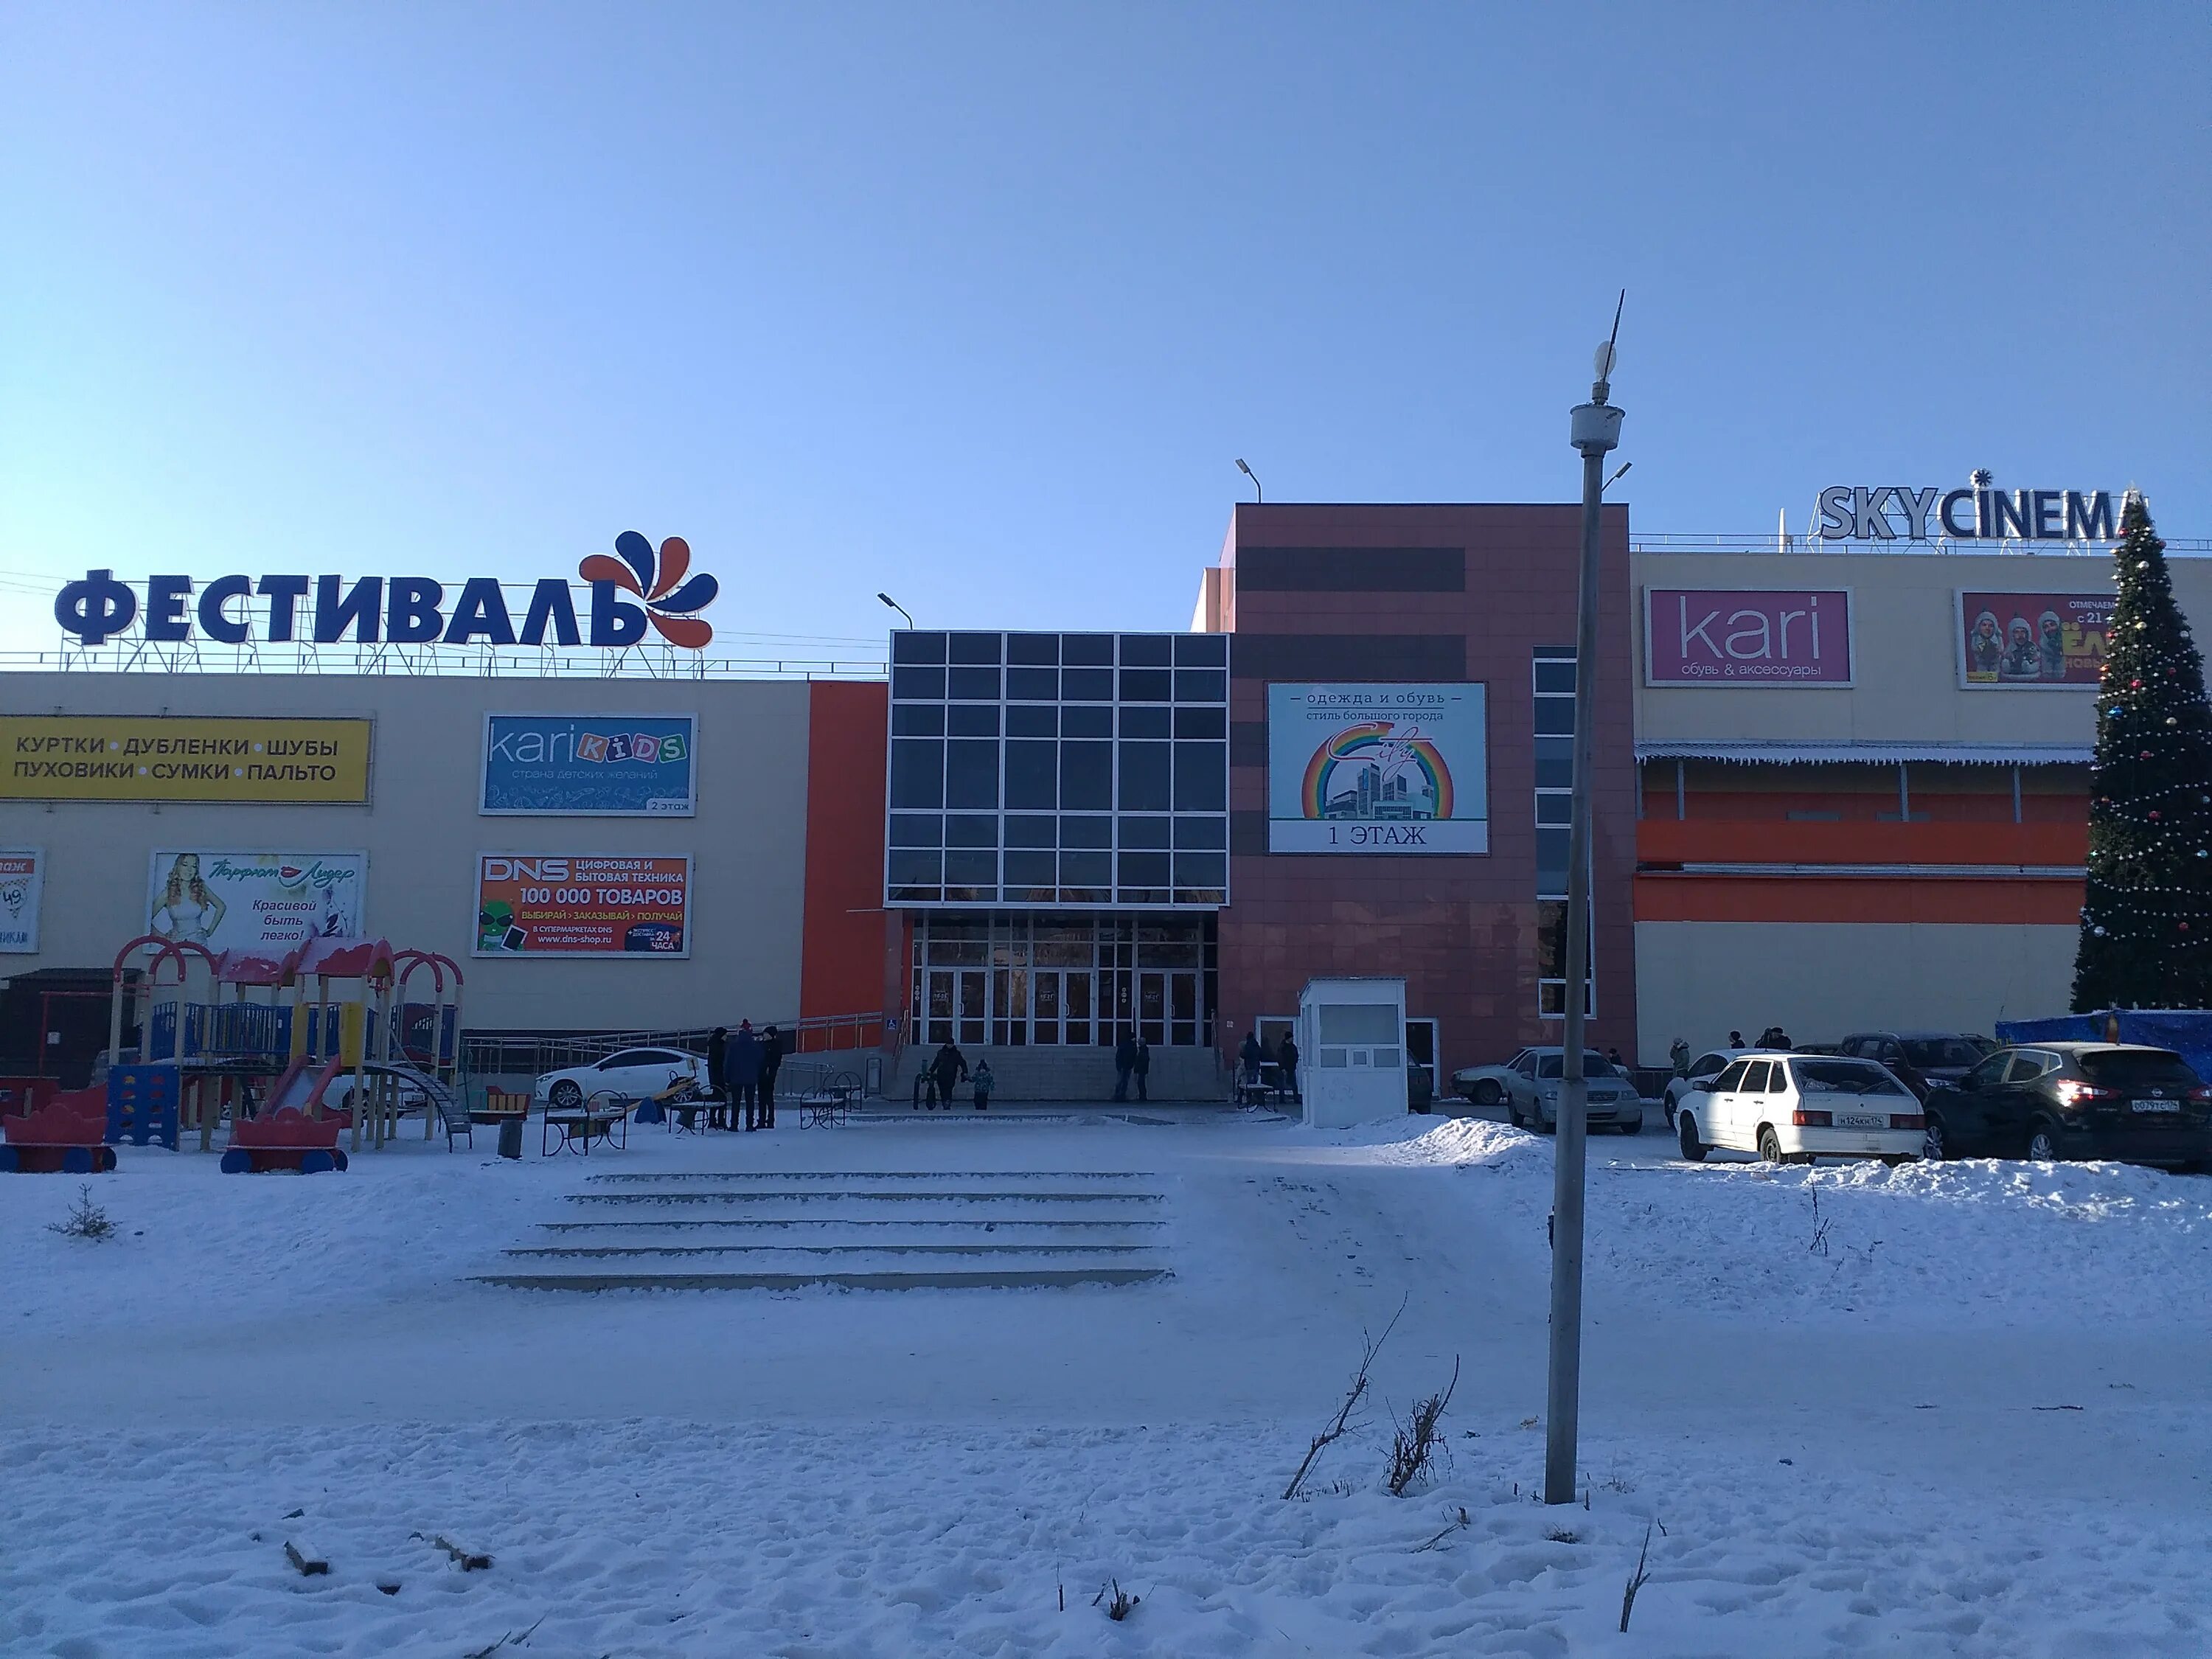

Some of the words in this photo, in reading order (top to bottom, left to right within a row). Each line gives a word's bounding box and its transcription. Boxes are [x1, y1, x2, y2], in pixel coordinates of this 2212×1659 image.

[1820, 485, 1939, 540] SKY
[55, 568, 650, 647] ФЕСТИВАЛЬ
[2069, 601, 2115, 609] ОТМЕЧАЕМ
[2087, 612, 2102, 623] 21
[1680, 596, 1819, 659] kari
[2061, 622, 2111, 655] ЁЛ
[1682, 662, 1719, 677] обувь
[1725, 664, 1734, 675] &
[1739, 664, 1821, 677] аксессуары
[1307, 693, 1373, 705] одежда
[1380, 694, 1389, 703] и
[1396, 692, 1445, 705] обувь
[1307, 711, 1340, 720] стиль
[1343, 710, 1400, 721] большого
[1402, 712, 1443, 723] города
[16, 737, 105, 754] КУРТКИ
[123, 738, 249, 757] ДУБЛЕНКИ
[266, 740, 338, 757] ШУБЫ
[488, 723, 575, 763] kari
[1327, 722, 1433, 782] City
[14, 761, 134, 779] ПУХОВИКИ
[152, 762, 230, 780] СУМКИ
[247, 764, 336, 782] ПАЛЬТО
[512, 770, 554, 780] страна
[557, 770, 604, 779] детских
[609, 769, 658, 779] желаний
[651, 801, 658, 810] 2
[1329, 826, 1339, 844] 1
[1350, 826, 1427, 845] ЭТАЖ
[484, 859, 570, 882] DNS
[575, 860, 641, 871] ЦИФРОВАЯ
[644, 860, 653, 870] И
[209, 858, 279, 883] Парфюм
[279, 860, 355, 888] Лидер
[574, 872, 629, 883] БЫТОВАЯ
[632, 873, 684, 883] ТЕХНИКА
[521, 887, 552, 904] 100
[555, 888, 591, 905] 000
[596, 888, 684, 905] ТОВАРОВ
[252, 899, 317, 913] Красивой
[264, 914, 304, 926] быть
[521, 908, 567, 920] ВЫБИРАЙ
[574, 910, 630, 921] ЗАКАЗЫВАЙ
[637, 911, 683, 921] ПОЛУЧАЙ
[260, 929, 305, 942] легко!
[539, 925, 597, 934] СУПЕРМАРКЕТАХ
[598, 926, 613, 934] DNS
[538, 934, 612, 945] www.dns-shop.ru
[656, 931, 670, 942] 24
[652, 942, 674, 950] ЧАСА
